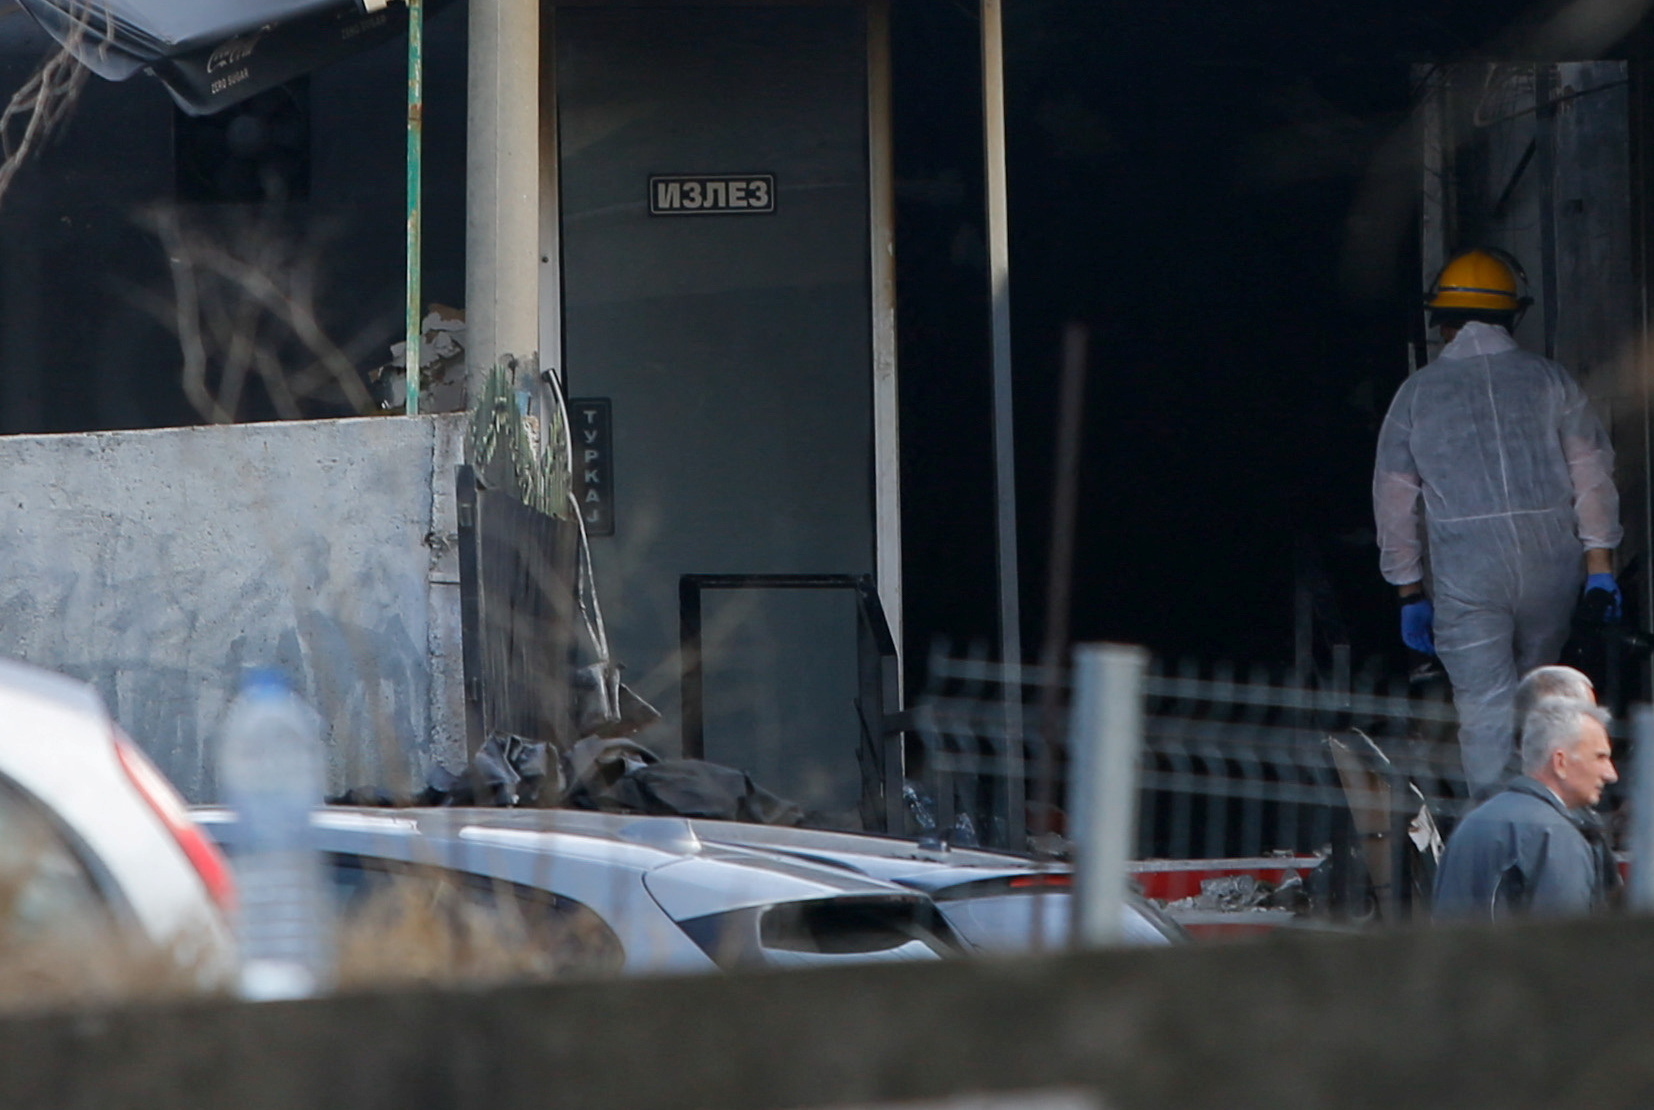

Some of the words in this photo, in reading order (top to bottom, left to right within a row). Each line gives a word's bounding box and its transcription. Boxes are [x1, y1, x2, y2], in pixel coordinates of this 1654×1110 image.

[210, 77, 227, 95] ZERO
[657, 180, 769, 209] ИЗЛЕЗ
[583, 410, 600, 523] ТУРКАЈ
